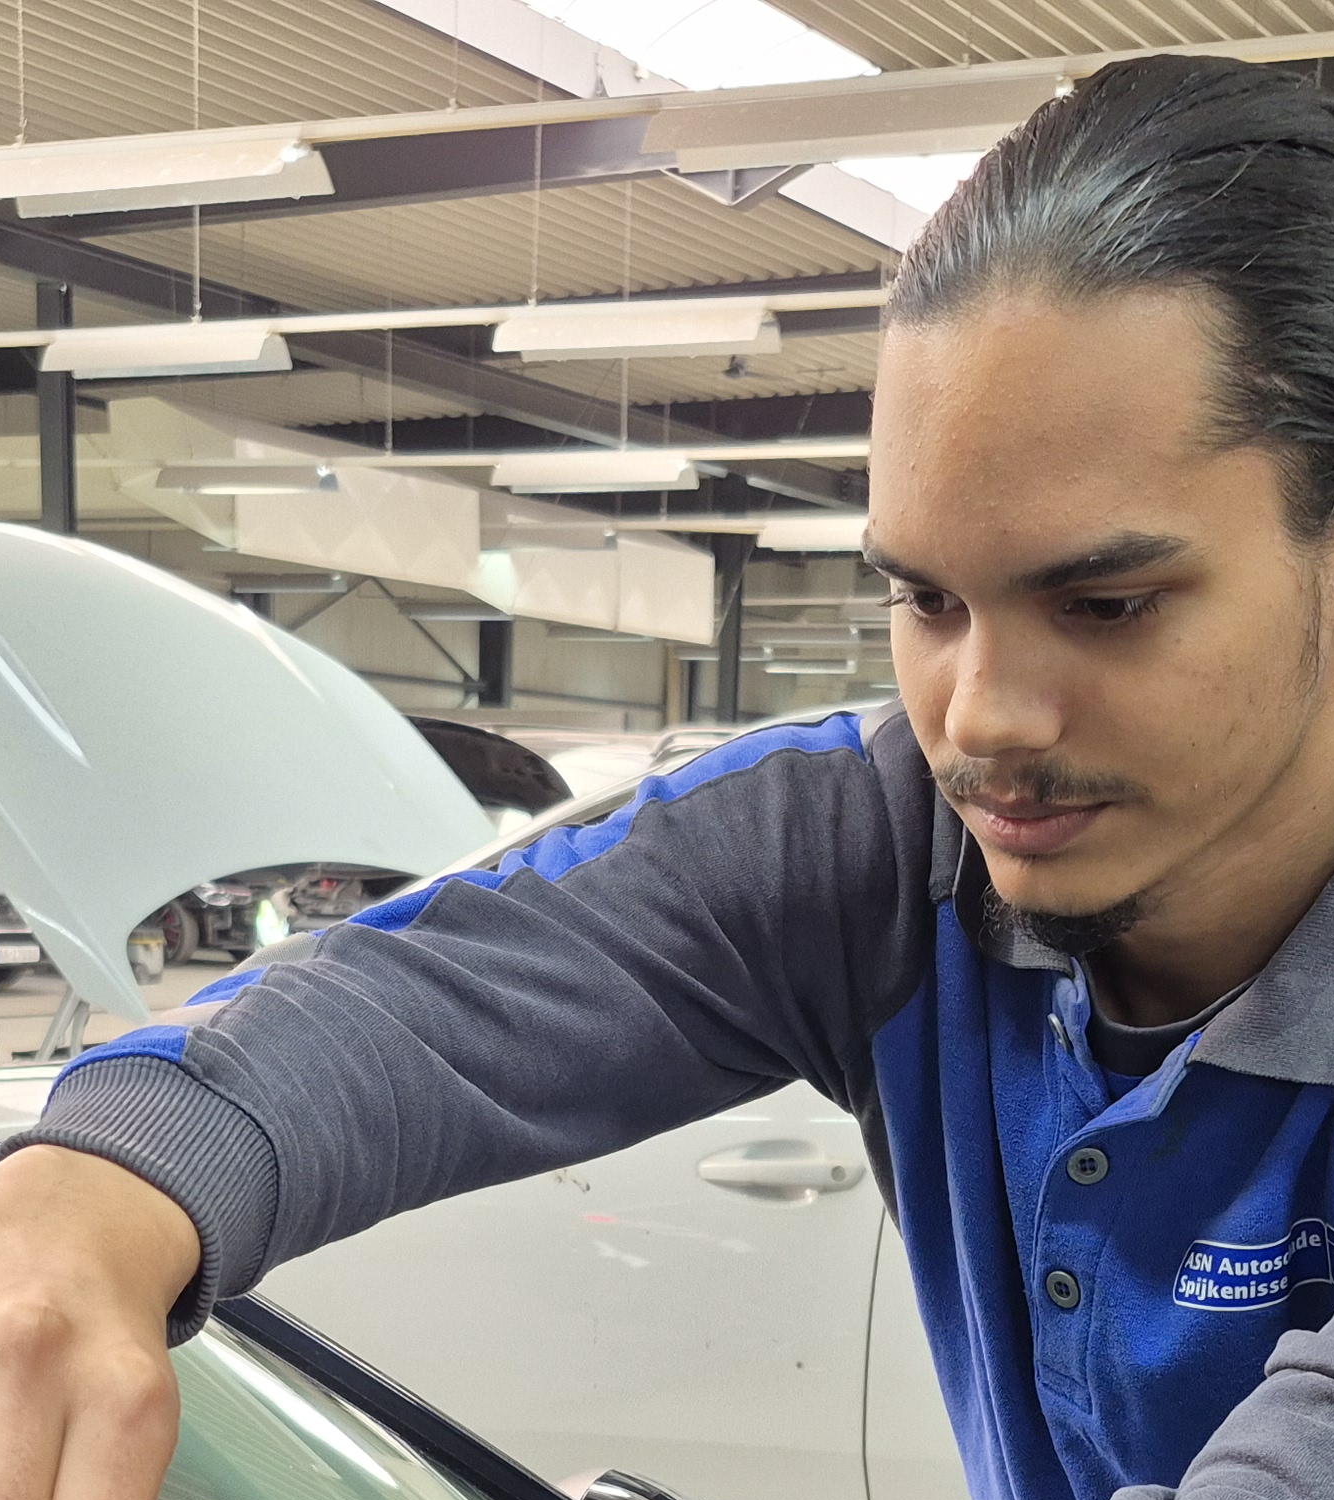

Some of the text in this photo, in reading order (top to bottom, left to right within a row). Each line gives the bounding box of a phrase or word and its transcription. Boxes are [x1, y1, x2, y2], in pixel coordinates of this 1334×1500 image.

[1184, 1230, 1322, 1277] ASN Autoscde
[1178, 1274, 1289, 1301] Spijkenisse
